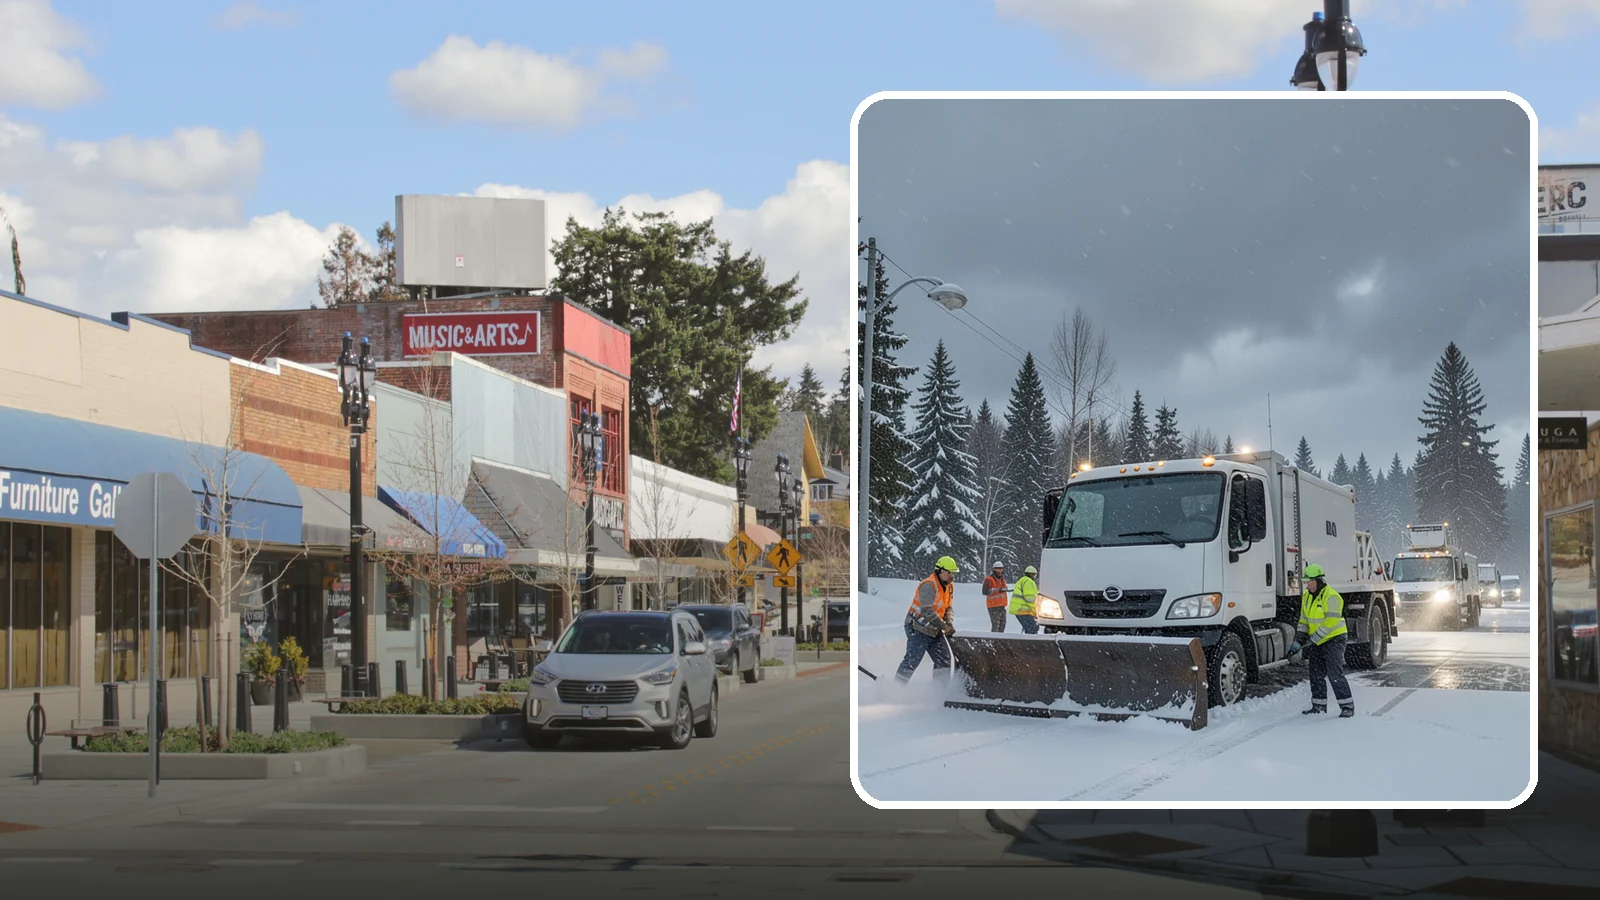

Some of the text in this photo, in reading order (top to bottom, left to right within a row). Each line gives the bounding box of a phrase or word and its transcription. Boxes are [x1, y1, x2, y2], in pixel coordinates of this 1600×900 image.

[409, 323, 519, 349] MUSIC&ARTS
[0, 471, 122, 519] Furniture Gal
[453, 563, 479, 574] SUSHI
